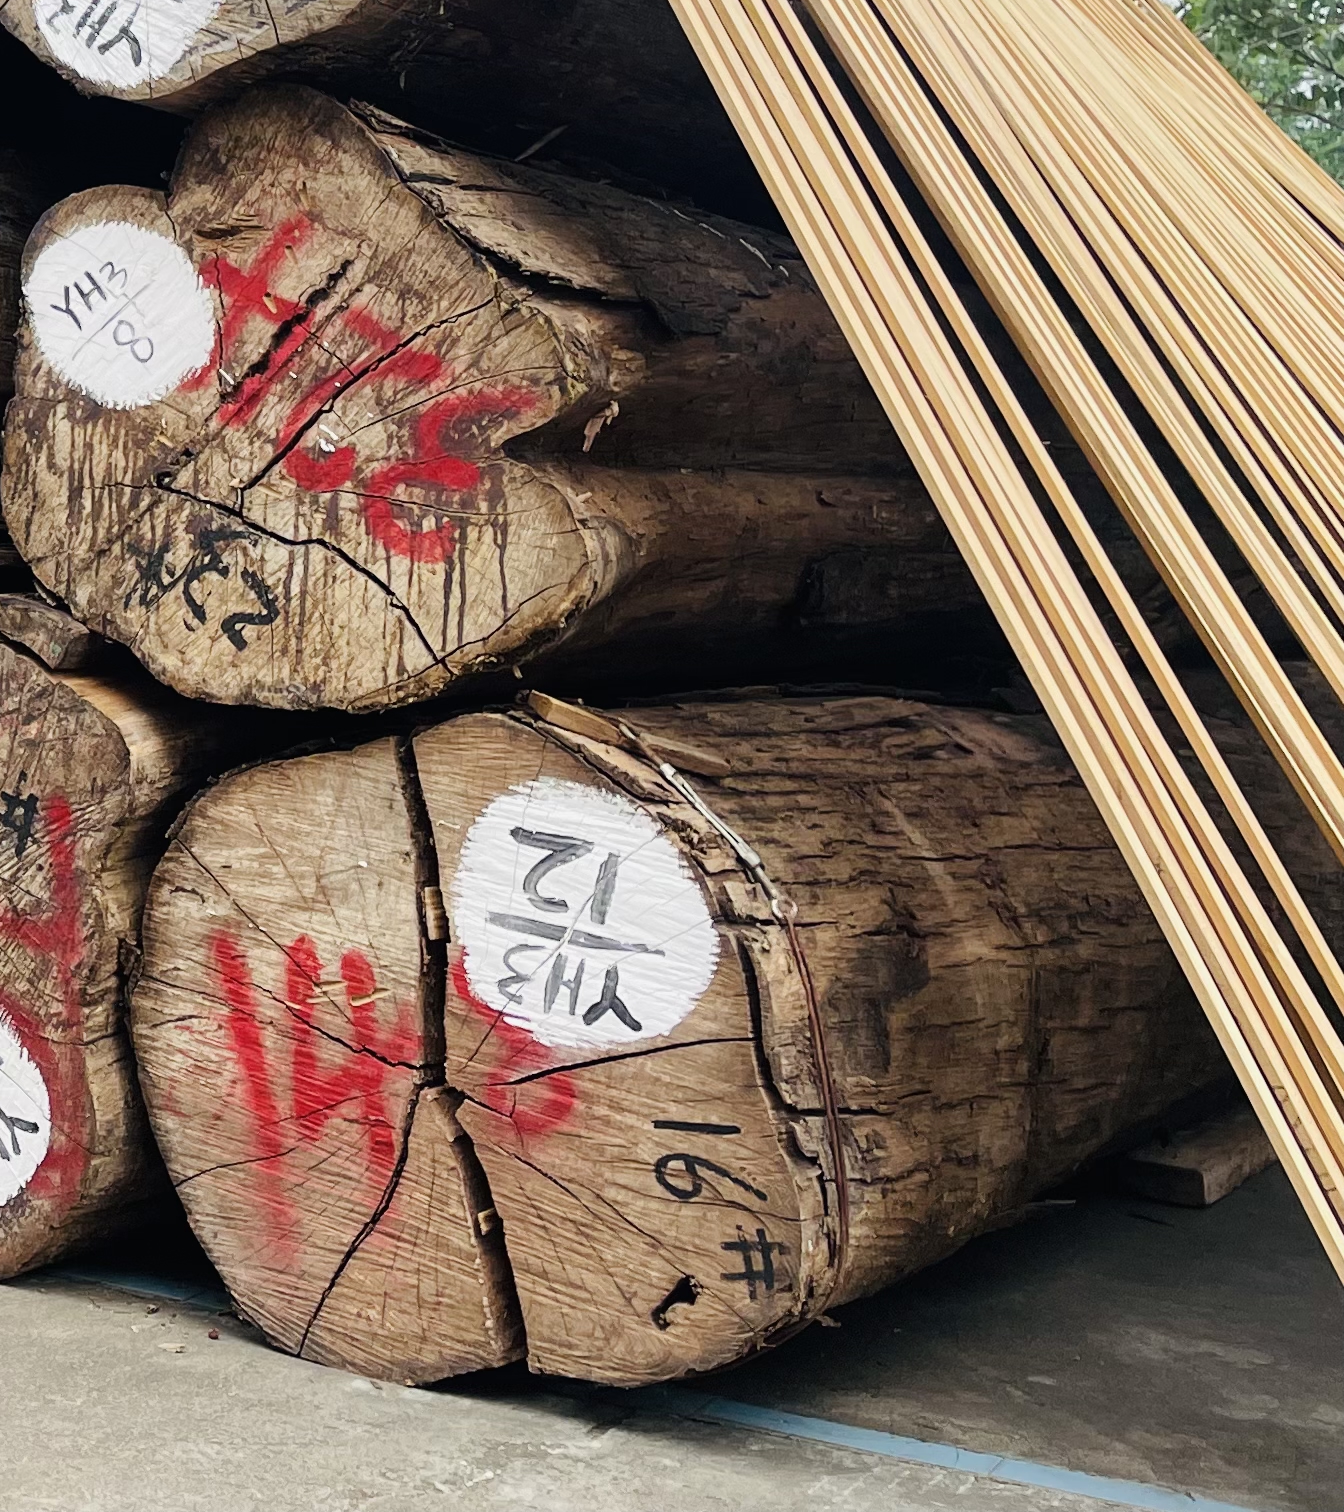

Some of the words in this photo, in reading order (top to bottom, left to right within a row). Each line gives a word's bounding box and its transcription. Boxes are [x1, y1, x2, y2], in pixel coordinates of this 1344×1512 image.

[50, 260, 130, 330] YH3
[112, 318, 155, 365] 8
[509, 826, 622, 925] 12
[497, 943, 645, 1034] YH3
